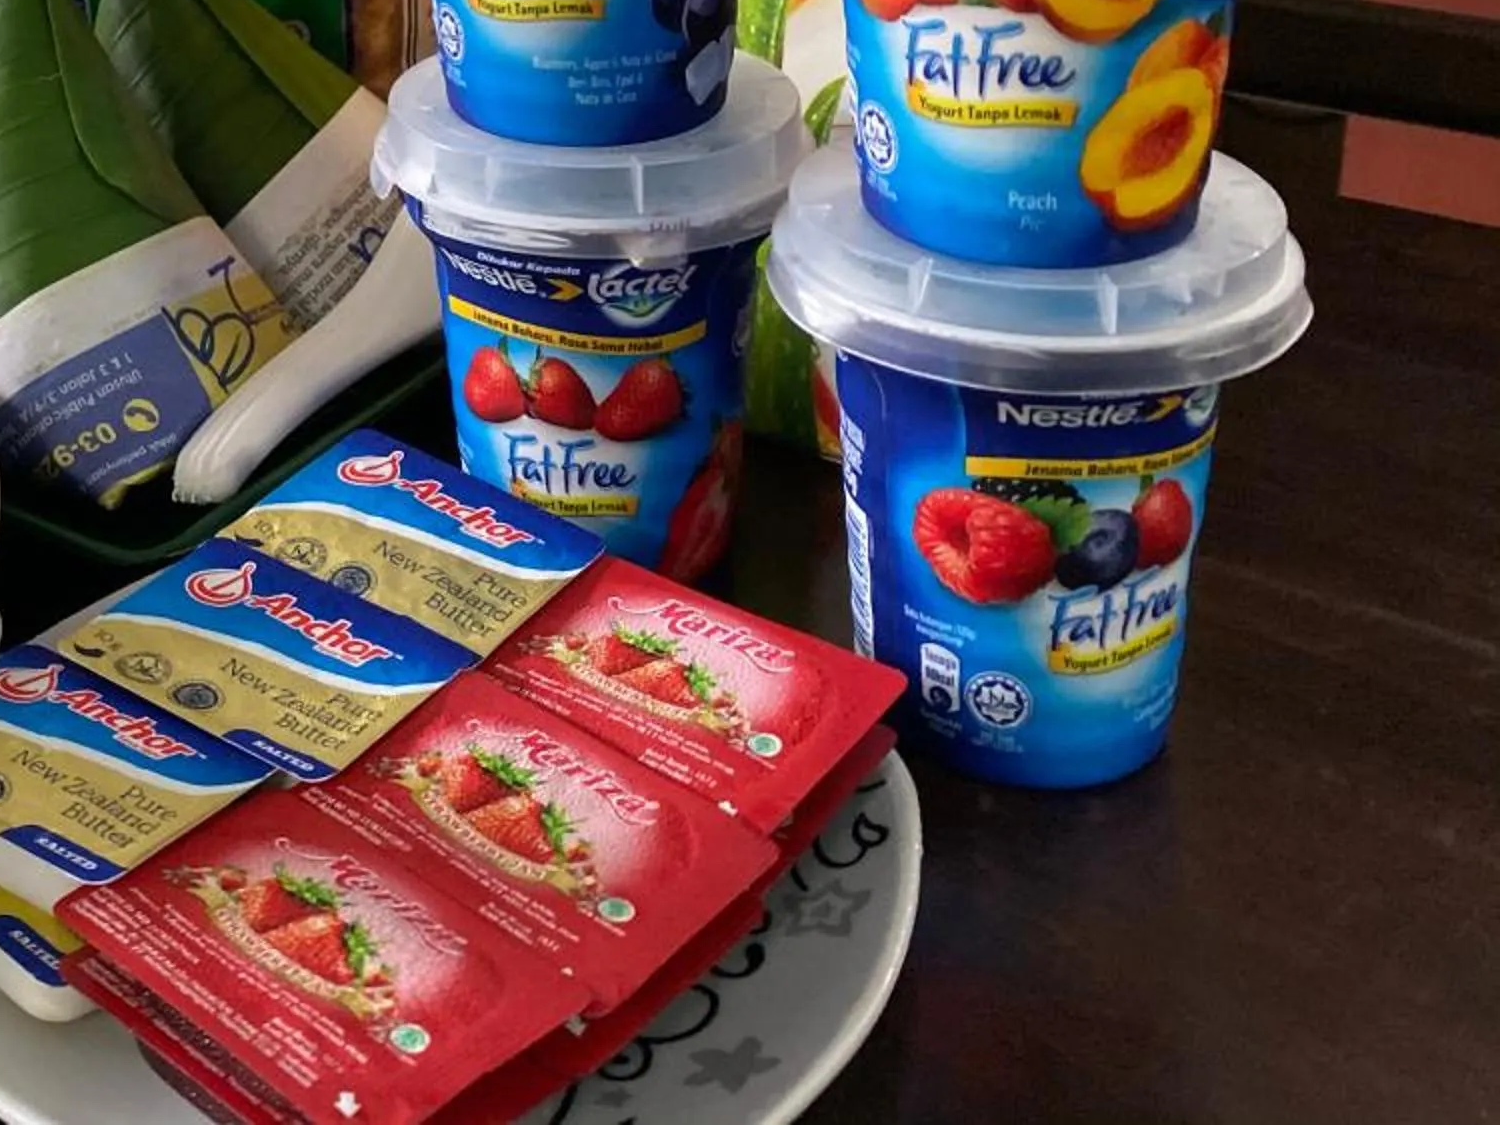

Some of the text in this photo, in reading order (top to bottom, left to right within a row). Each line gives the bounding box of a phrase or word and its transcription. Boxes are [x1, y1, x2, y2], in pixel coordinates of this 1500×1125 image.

[552, 1, 594, 15] Lemak
[974, 20, 1076, 101] Free
[968, 104, 1010, 124] Tanpa
[1014, 105, 1062, 123] Lemak
[1008, 190, 1058, 213] Peach
[57, 368, 98, 396] Jalan
[557, 438, 639, 495] Free
[399, 477, 536, 546] Anchor
[373, 539, 515, 623] New Zealand
[474, 572, 528, 607] Pure
[249, 593, 393, 662] Anchor
[423, 590, 496, 638] Butter
[218, 656, 368, 738] New Zealand
[326, 691, 384, 723] Pure
[49, 688, 199, 756] Anchor
[251, 738, 316, 774] SALTED
[11, 748, 168, 838] New Zealand
[119, 782, 178, 823] Pure
[61, 801, 138, 850] Butter
[34, 834, 99, 871] SALTED
